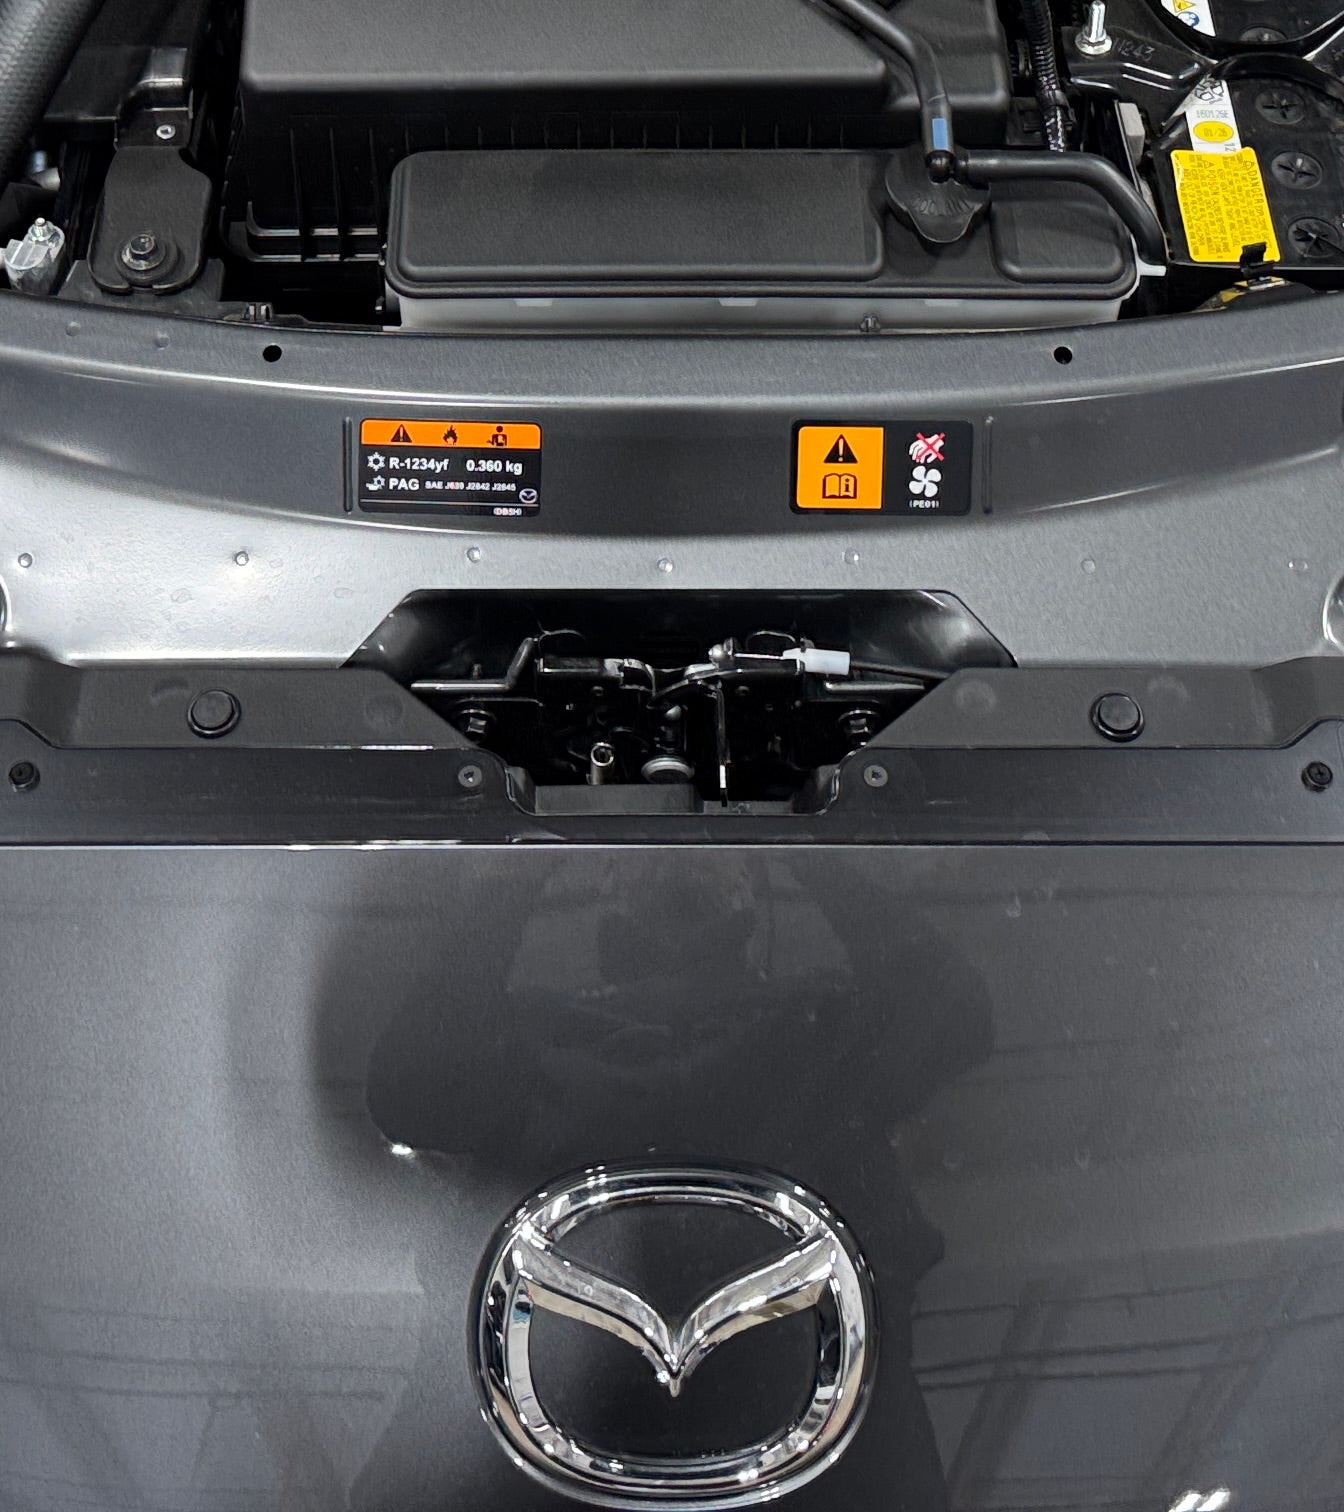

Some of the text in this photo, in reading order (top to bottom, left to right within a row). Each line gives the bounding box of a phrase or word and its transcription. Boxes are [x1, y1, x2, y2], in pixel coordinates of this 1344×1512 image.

[388, 457, 524, 476] R-1234yf 0.360 kg
[388, 478, 420, 491] PAG
[424, 481, 444, 490] SAE
